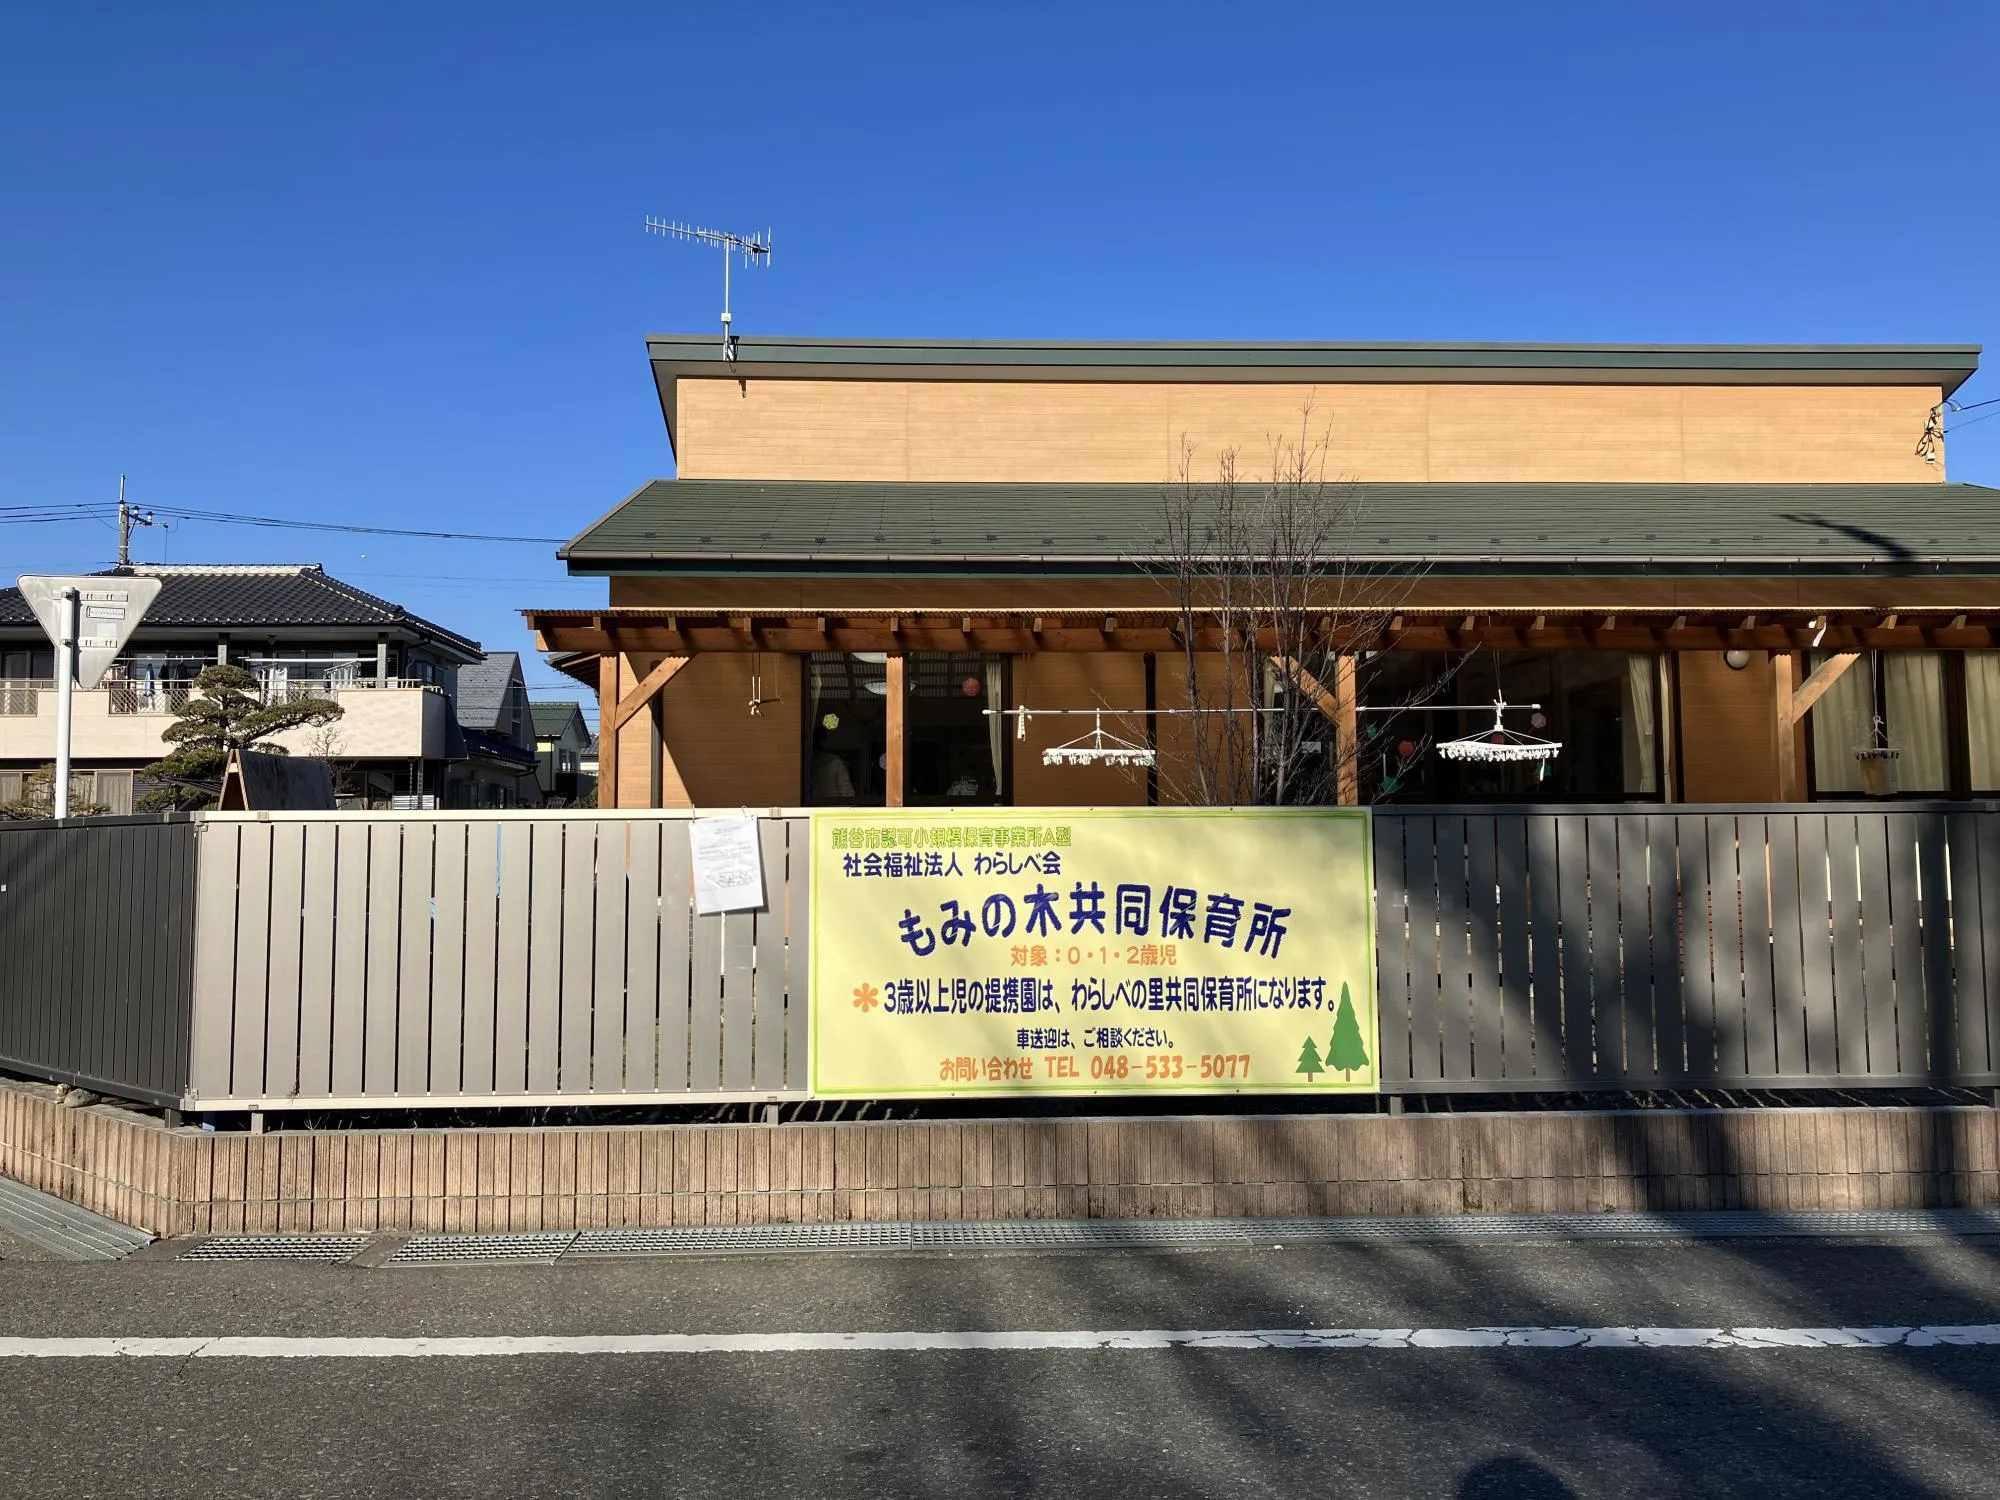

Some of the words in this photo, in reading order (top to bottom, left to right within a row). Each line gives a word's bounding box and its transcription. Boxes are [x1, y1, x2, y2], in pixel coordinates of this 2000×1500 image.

[843, 852, 963, 878] 社会福祉法人
[974, 851, 1061, 876] わらしべ会
[899, 882, 1291, 958] もみの木共同保育所
[939, 1055, 1034, 1082] お問い合わせ
[1044, 1055, 1080, 1078] TEL
[1090, 1054, 1251, 1080] 048-533-5077
